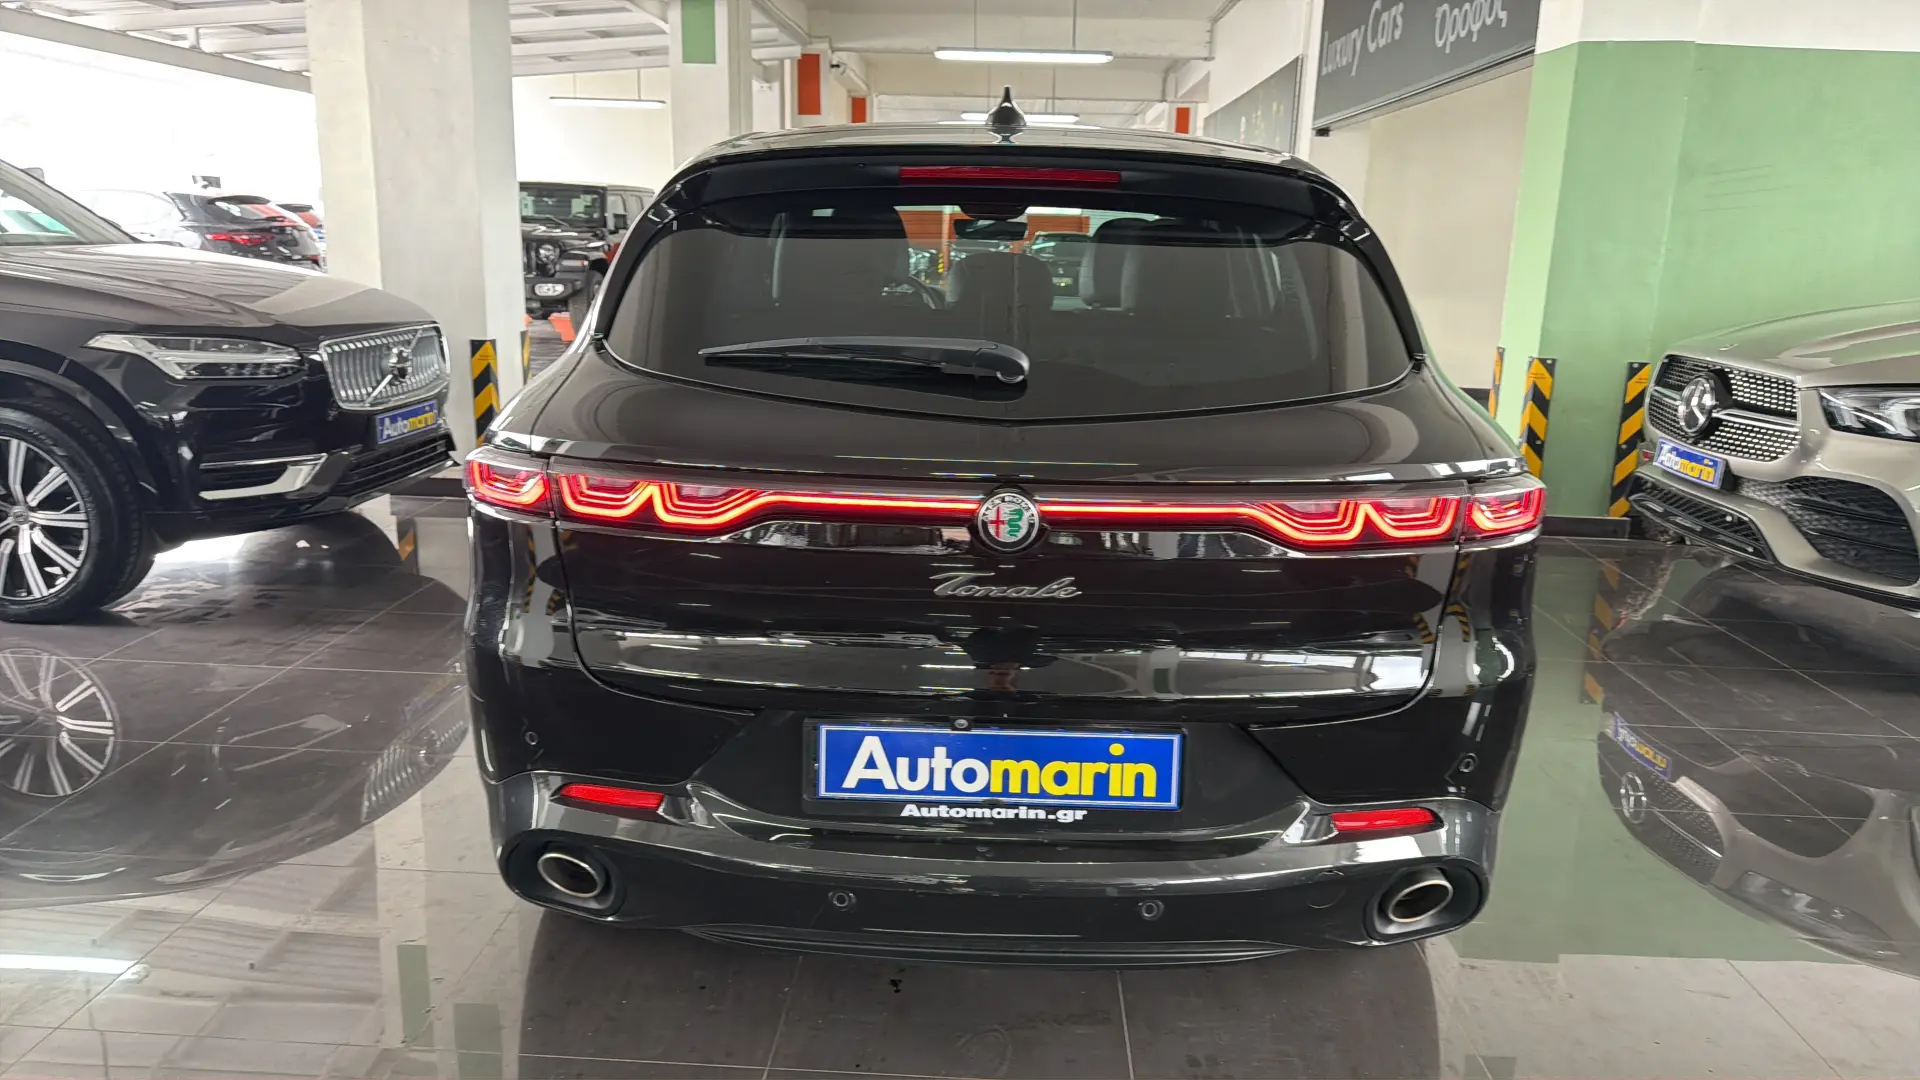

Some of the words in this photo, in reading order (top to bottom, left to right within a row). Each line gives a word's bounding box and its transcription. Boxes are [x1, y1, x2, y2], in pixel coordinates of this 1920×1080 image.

[1321, 25, 1366, 76] Luxury
[1367, 0, 1405, 53] Cars
[929, 571, 1083, 599] Tonale
[841, 735, 1157, 797] Automarin
[900, 803, 1088, 822] Automarin.gr
